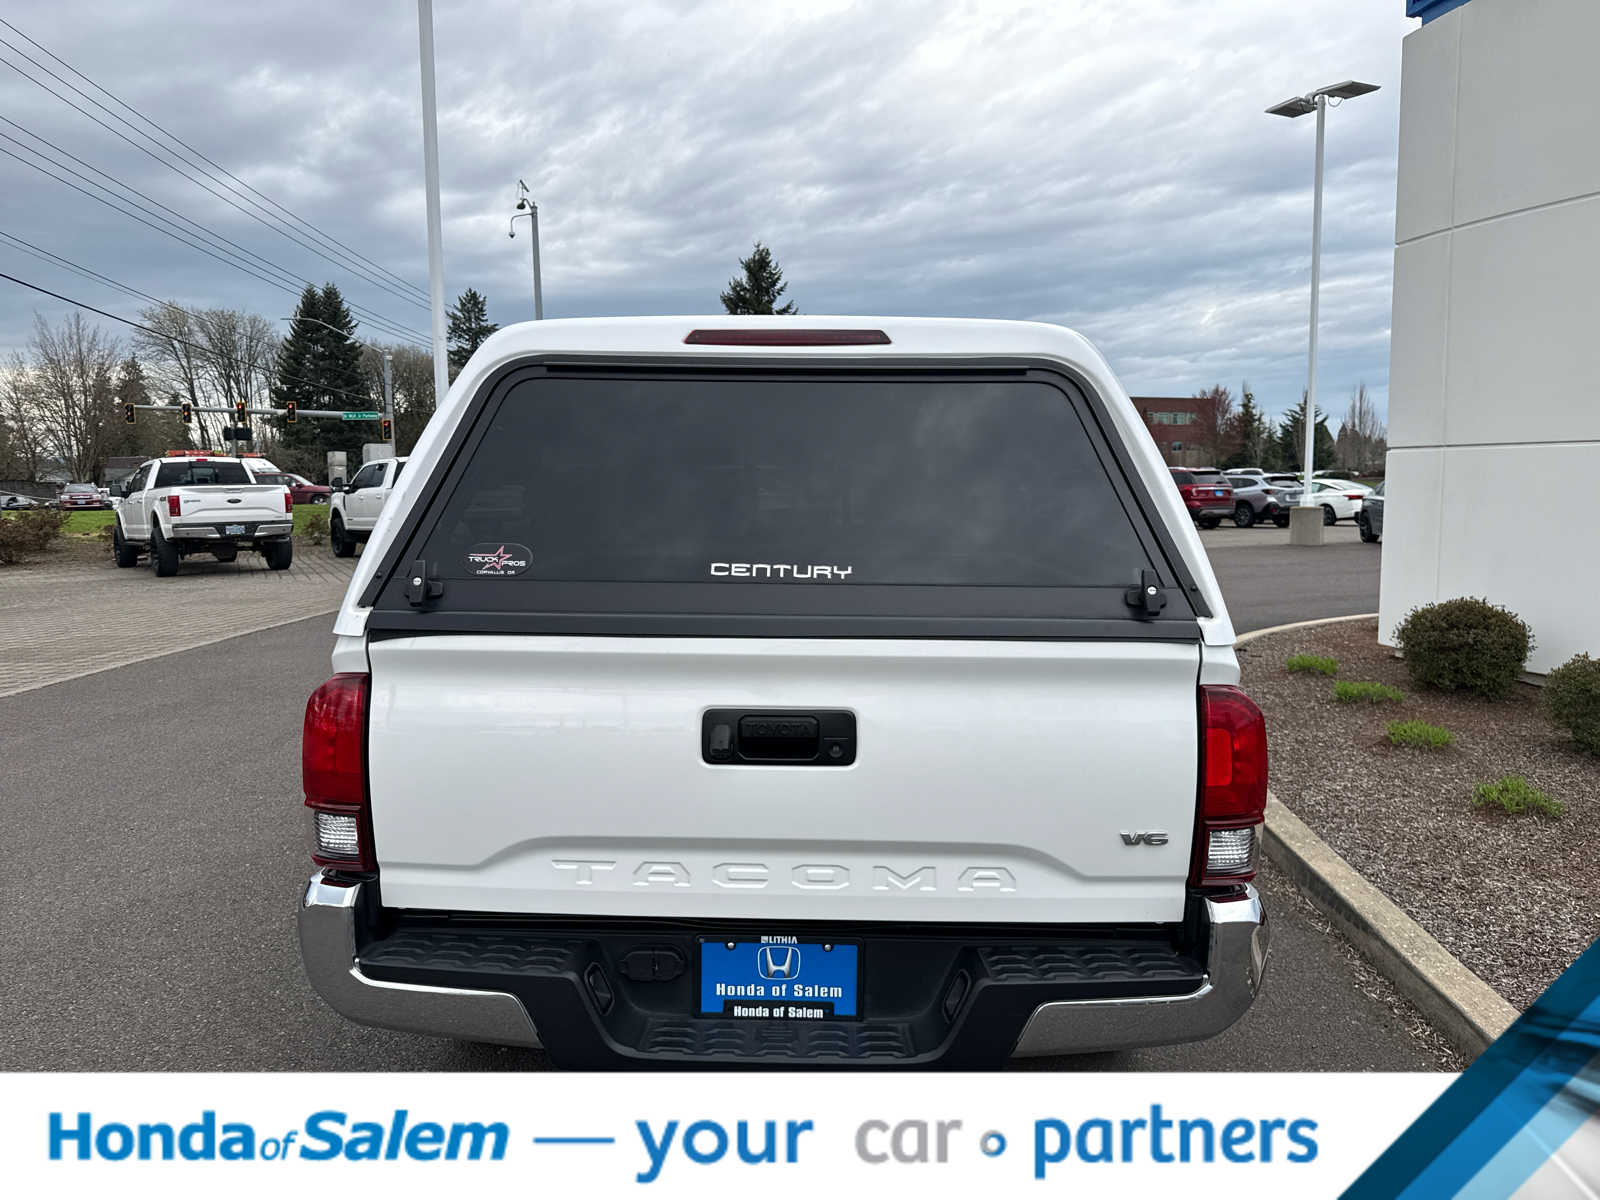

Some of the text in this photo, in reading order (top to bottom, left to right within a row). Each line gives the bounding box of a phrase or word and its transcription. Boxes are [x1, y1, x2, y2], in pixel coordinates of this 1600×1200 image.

[710, 562, 853, 579] CENTURY
[1119, 831, 1169, 846] V6
[551, 859, 1017, 892] TACOMA
[769, 936, 798, 944] LITHIA
[716, 983, 842, 998] Honda of Salem
[733, 1006, 824, 1019] Honda of Salem
